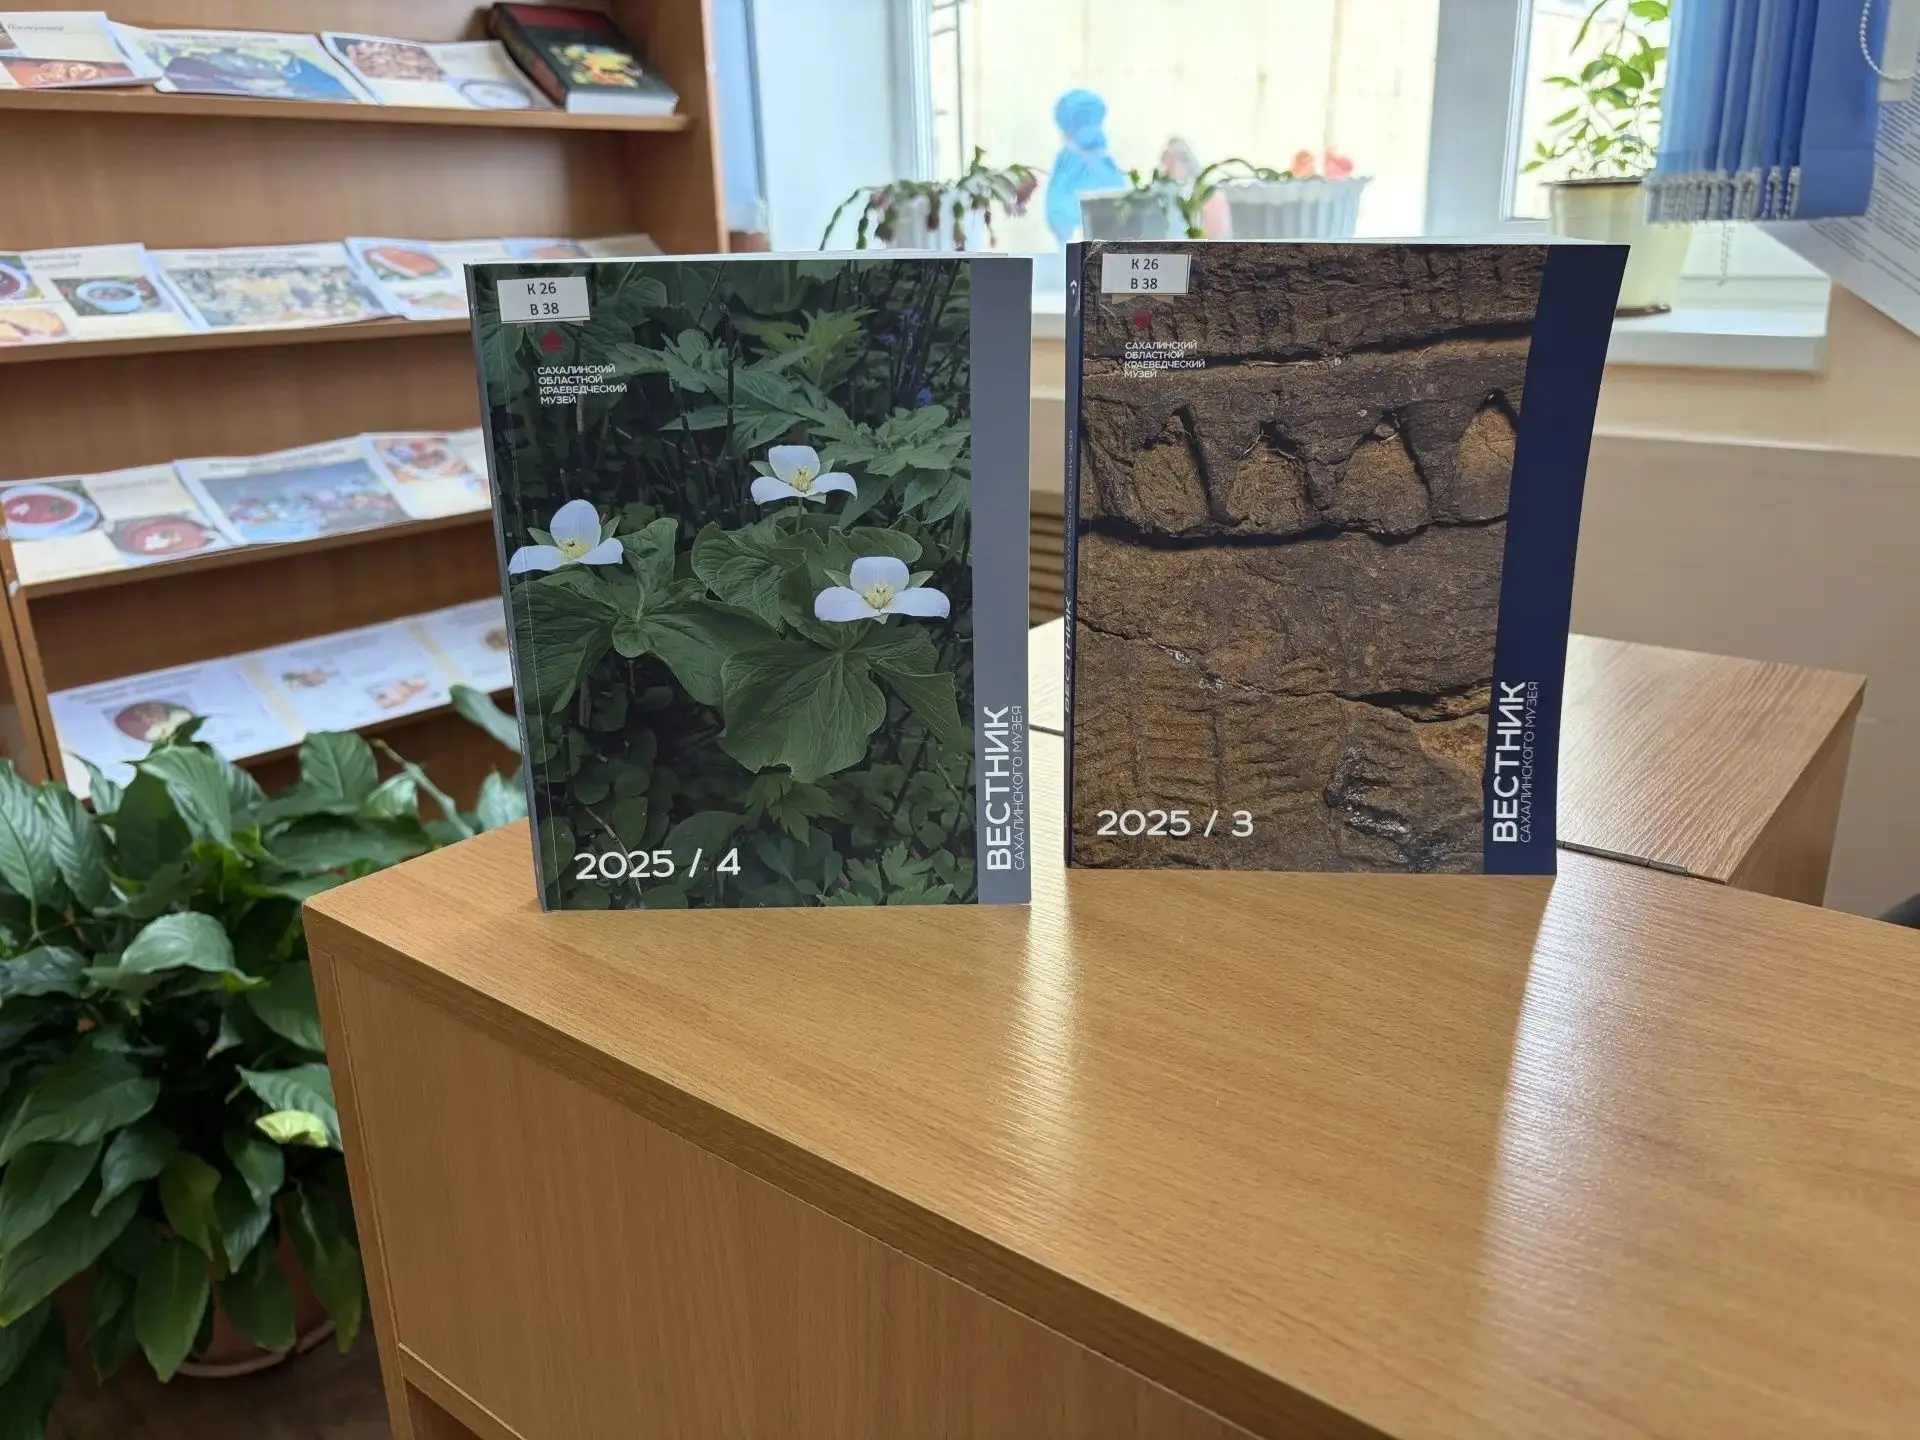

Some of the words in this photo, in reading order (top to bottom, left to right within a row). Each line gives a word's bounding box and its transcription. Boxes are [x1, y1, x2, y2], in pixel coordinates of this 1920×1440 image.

[1131, 258, 1140, 270] К
[1143, 258, 1159, 270] 26
[527, 283, 537, 295] К
[540, 281, 557, 295] 26
[1130, 278, 1138, 290] В
[1142, 278, 1158, 290] 38
[530, 303, 539, 316] В
[543, 302, 560, 315] 38
[1125, 339, 1198, 350] САХАЛИНСКИЙ
[1124, 349, 1184, 360] ОБЛАСТНОЙ
[537, 363, 616, 375] САХАЛИНСКИЙ
[1124, 359, 1206, 370] КРАЕВЕДЧЕСКИЙ
[538, 373, 603, 385] ОБЛАСТНОЙ
[1123, 369, 1158, 379] МУЗЕЙ
[539, 383, 628, 395] КРАЕВЕДЧЕСКИЙ
[540, 393, 577, 405] МУЗЕЙ
[1525, 681, 1539, 728] МУЗЕЯ
[1011, 705, 1024, 753] МУЗЕЯ
[1492, 681, 1526, 843] ВЕСТНИК
[983, 706, 1012, 870] ВЕСТНИК
[1520, 731, 1535, 843] САХАЛИНСКОГО
[1012, 756, 1025, 870] САХАЛИНСКОГО
[1096, 809, 1191, 837] 2025
[1203, 809, 1219, 838] /
[1231, 810, 1254, 838] 3
[573, 850, 675, 880] 2025
[688, 847, 703, 878] /
[716, 847, 742, 876] 4
